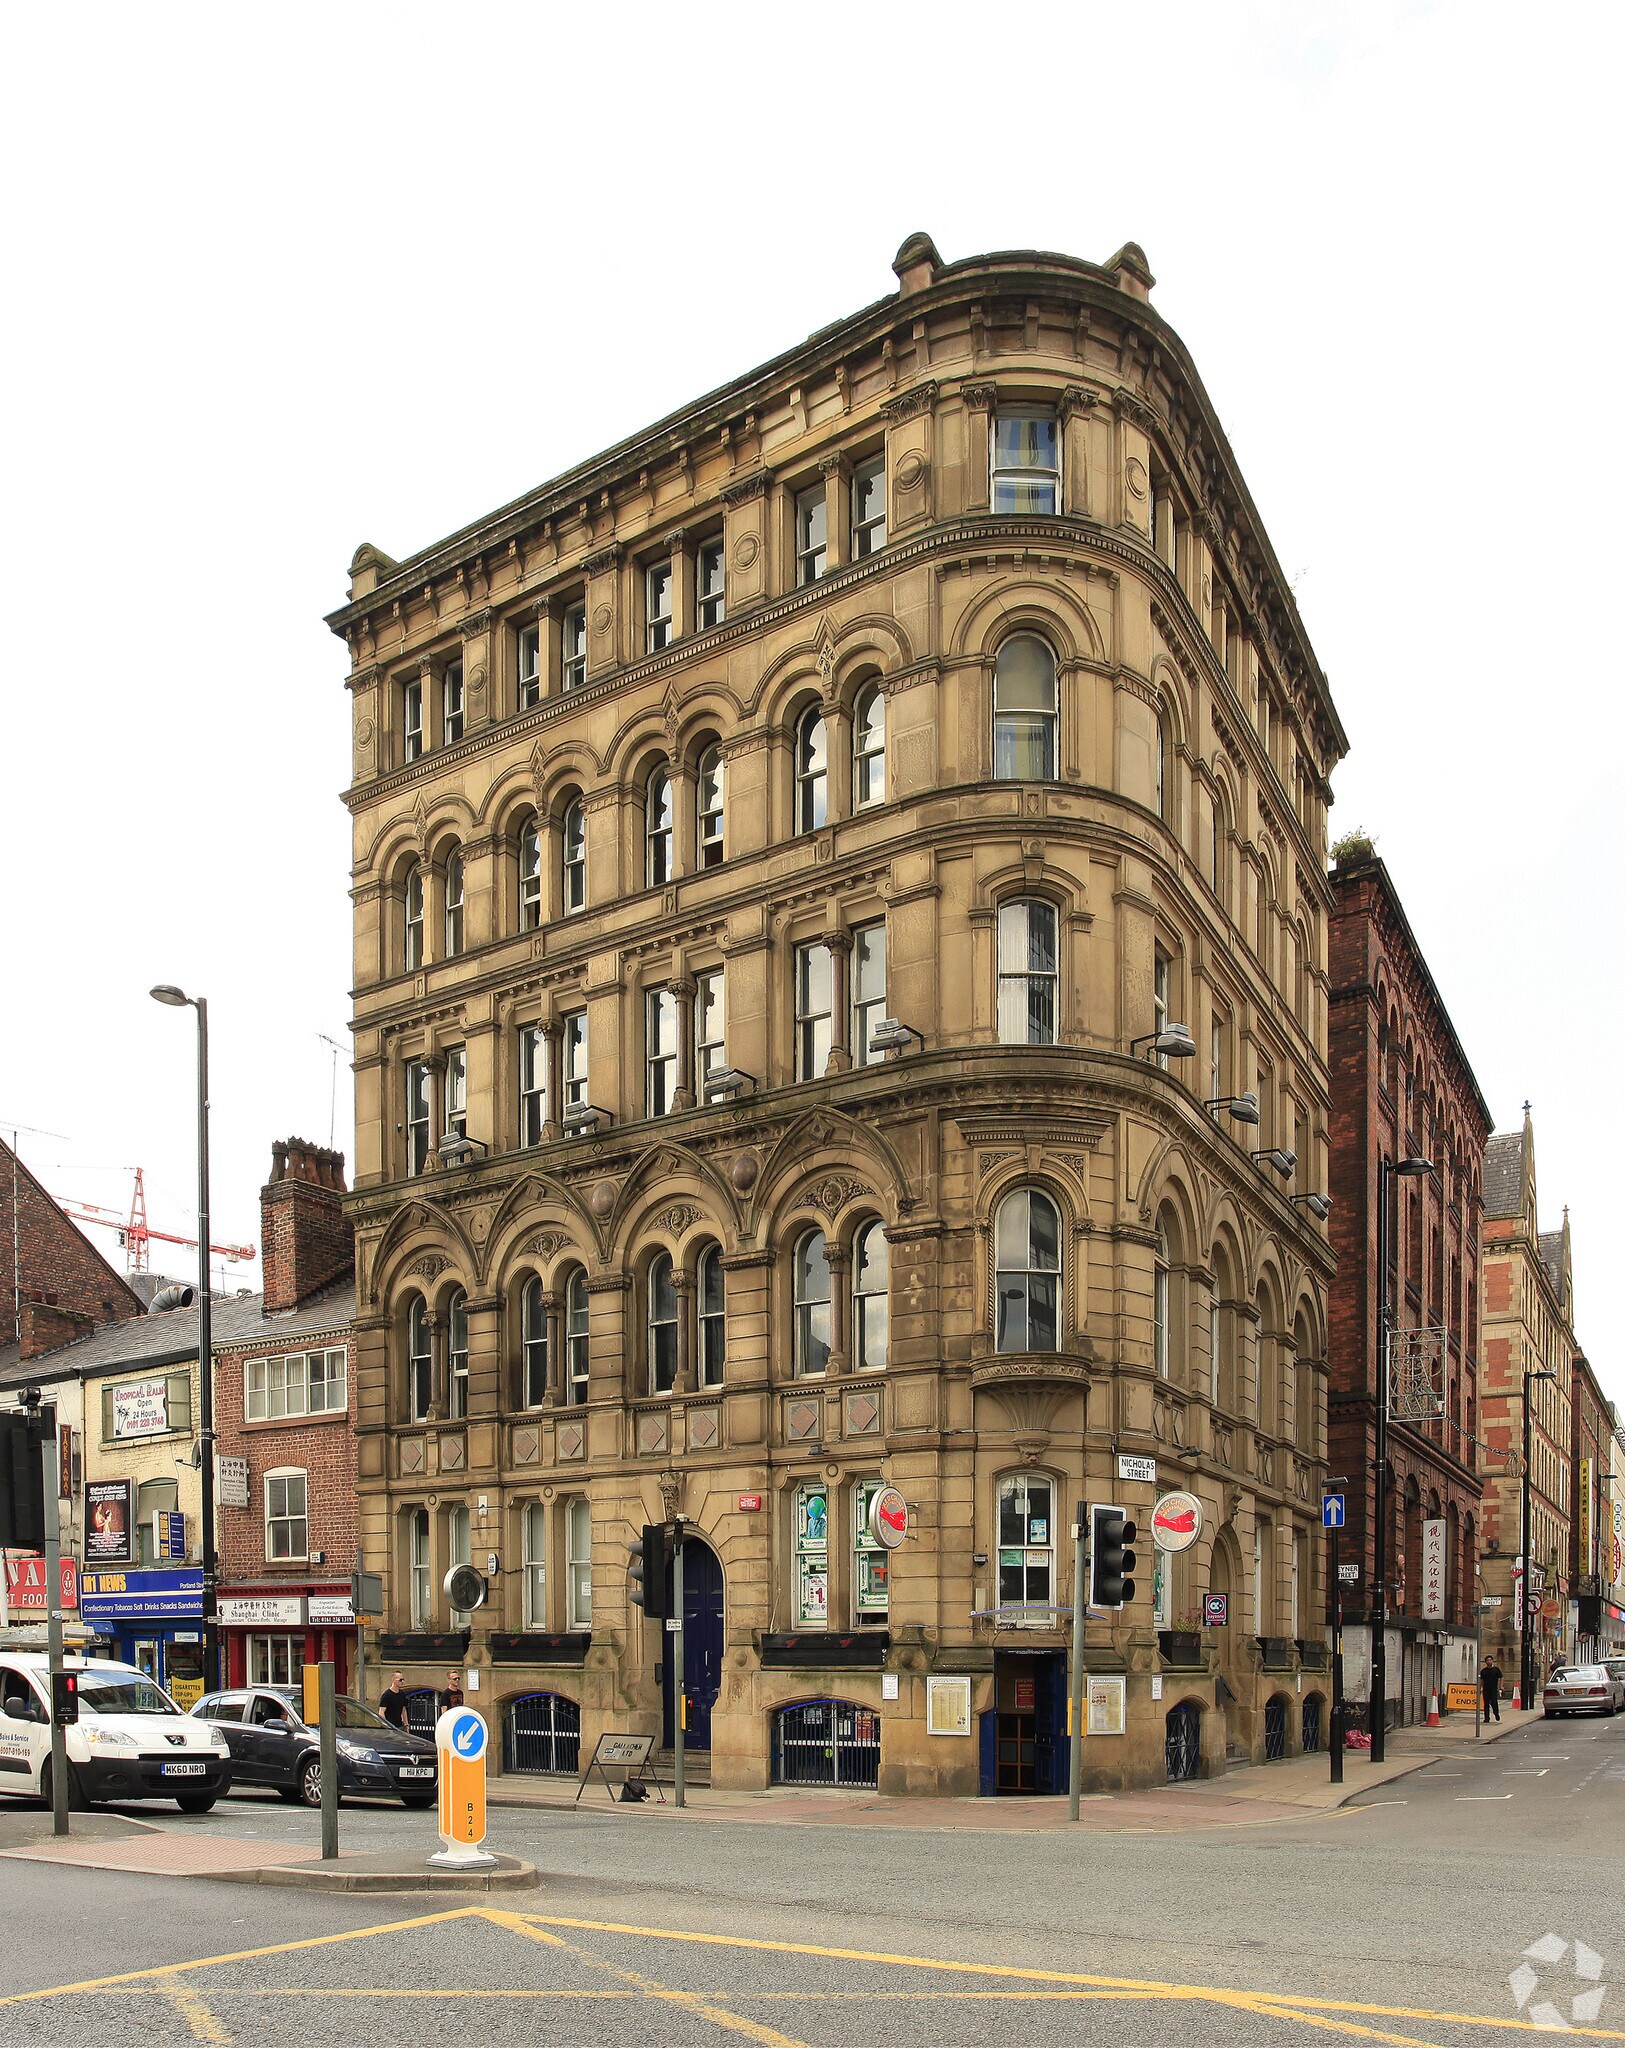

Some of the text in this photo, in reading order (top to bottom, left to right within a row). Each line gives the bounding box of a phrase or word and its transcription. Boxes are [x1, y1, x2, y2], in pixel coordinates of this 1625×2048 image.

[137, 1399, 152, 1408] Open
[140, 1410, 157, 1419] Hours
[1122, 1458, 1154, 1470] NICHOLAS
[1127, 1469, 1149, 1479] STREET
[83, 1574, 126, 1592] M1 NEWS
[114, 1603, 133, 1611] Tobacco
[160, 1602, 177, 1610] Snacks
[178, 1601, 203, 1609] Sandwiche
[231, 1610, 258, 1618] Shanghai
[14, 1734, 29, 1742] Service
